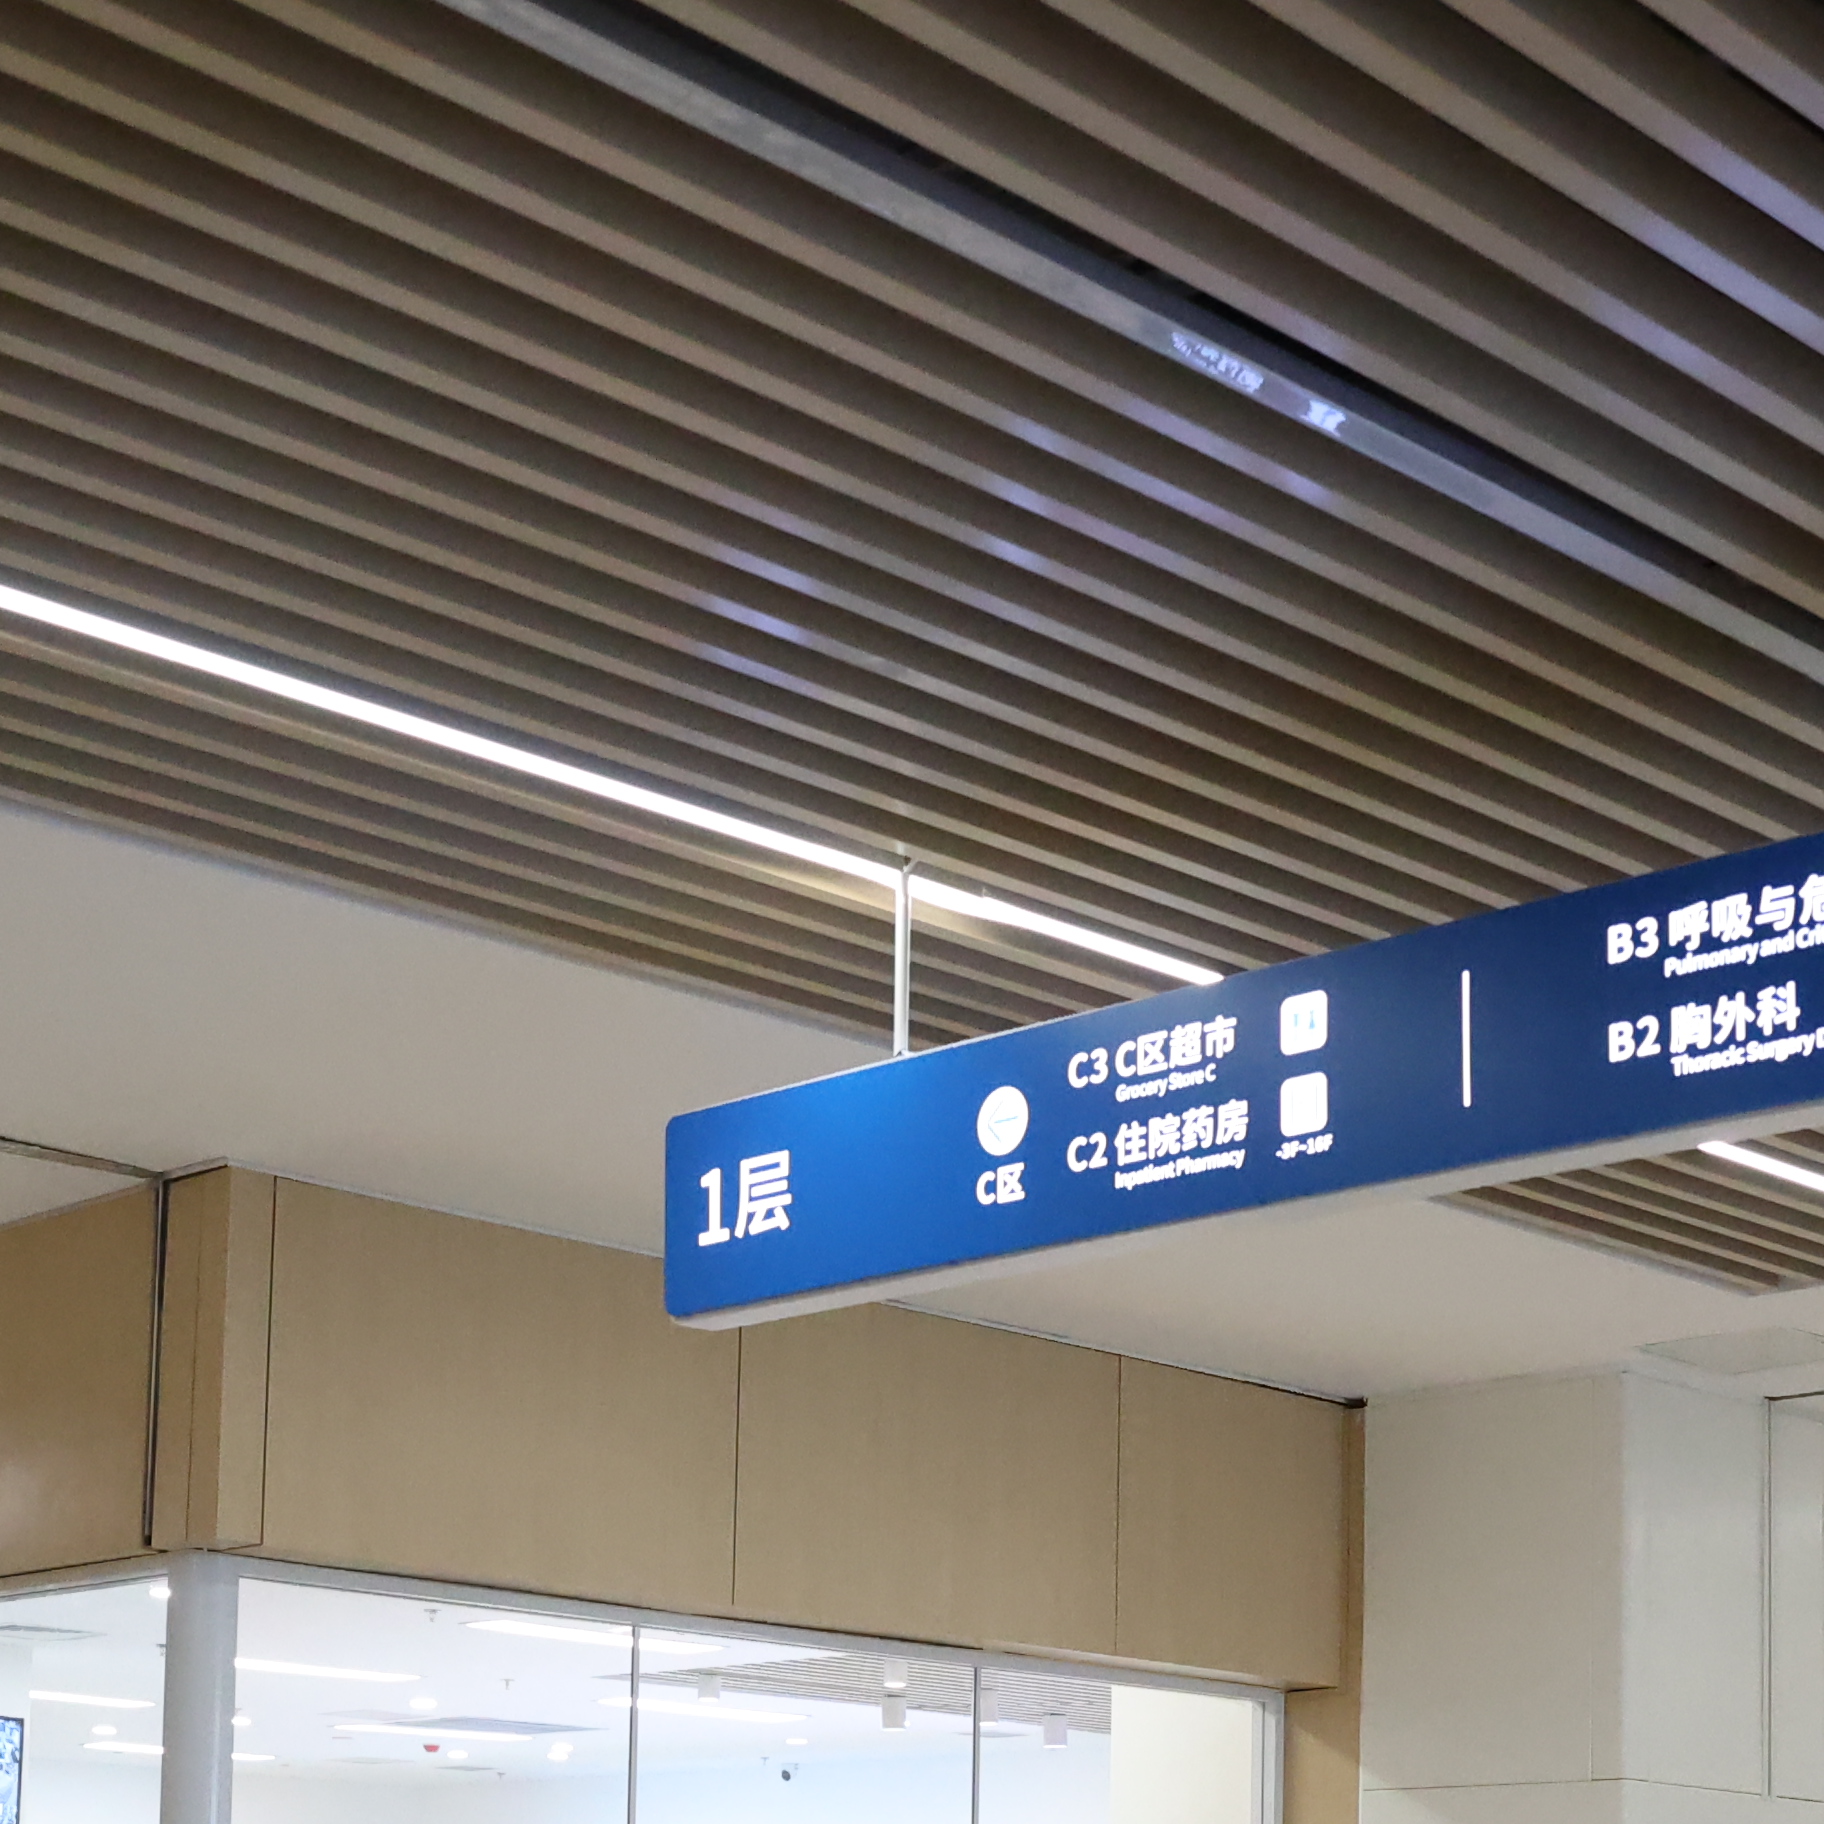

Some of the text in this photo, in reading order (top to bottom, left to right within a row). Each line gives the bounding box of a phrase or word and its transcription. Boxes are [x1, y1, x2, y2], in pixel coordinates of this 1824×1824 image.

[1607, 916, 1659, 965] B3
[1663, 938, 1760, 979] Pulmonary
[1760, 928, 1795, 956] and
[1608, 980, 1801, 1063] B2 胸外科
[1067, 1014, 1238, 1089] C3 C区超市
[1669, 1045, 1746, 1077] Thoracic
[1746, 1031, 1816, 1063] Surgery
[1115, 1062, 1217, 1103] Grocery Store C
[1066, 1098, 1249, 1172] C2 住院药房
[976, 1162, 1028, 1206] C区
[1114, 1148, 1247, 1191] Inpatient Pharmacy
[697, 1148, 794, 1247] 1层
